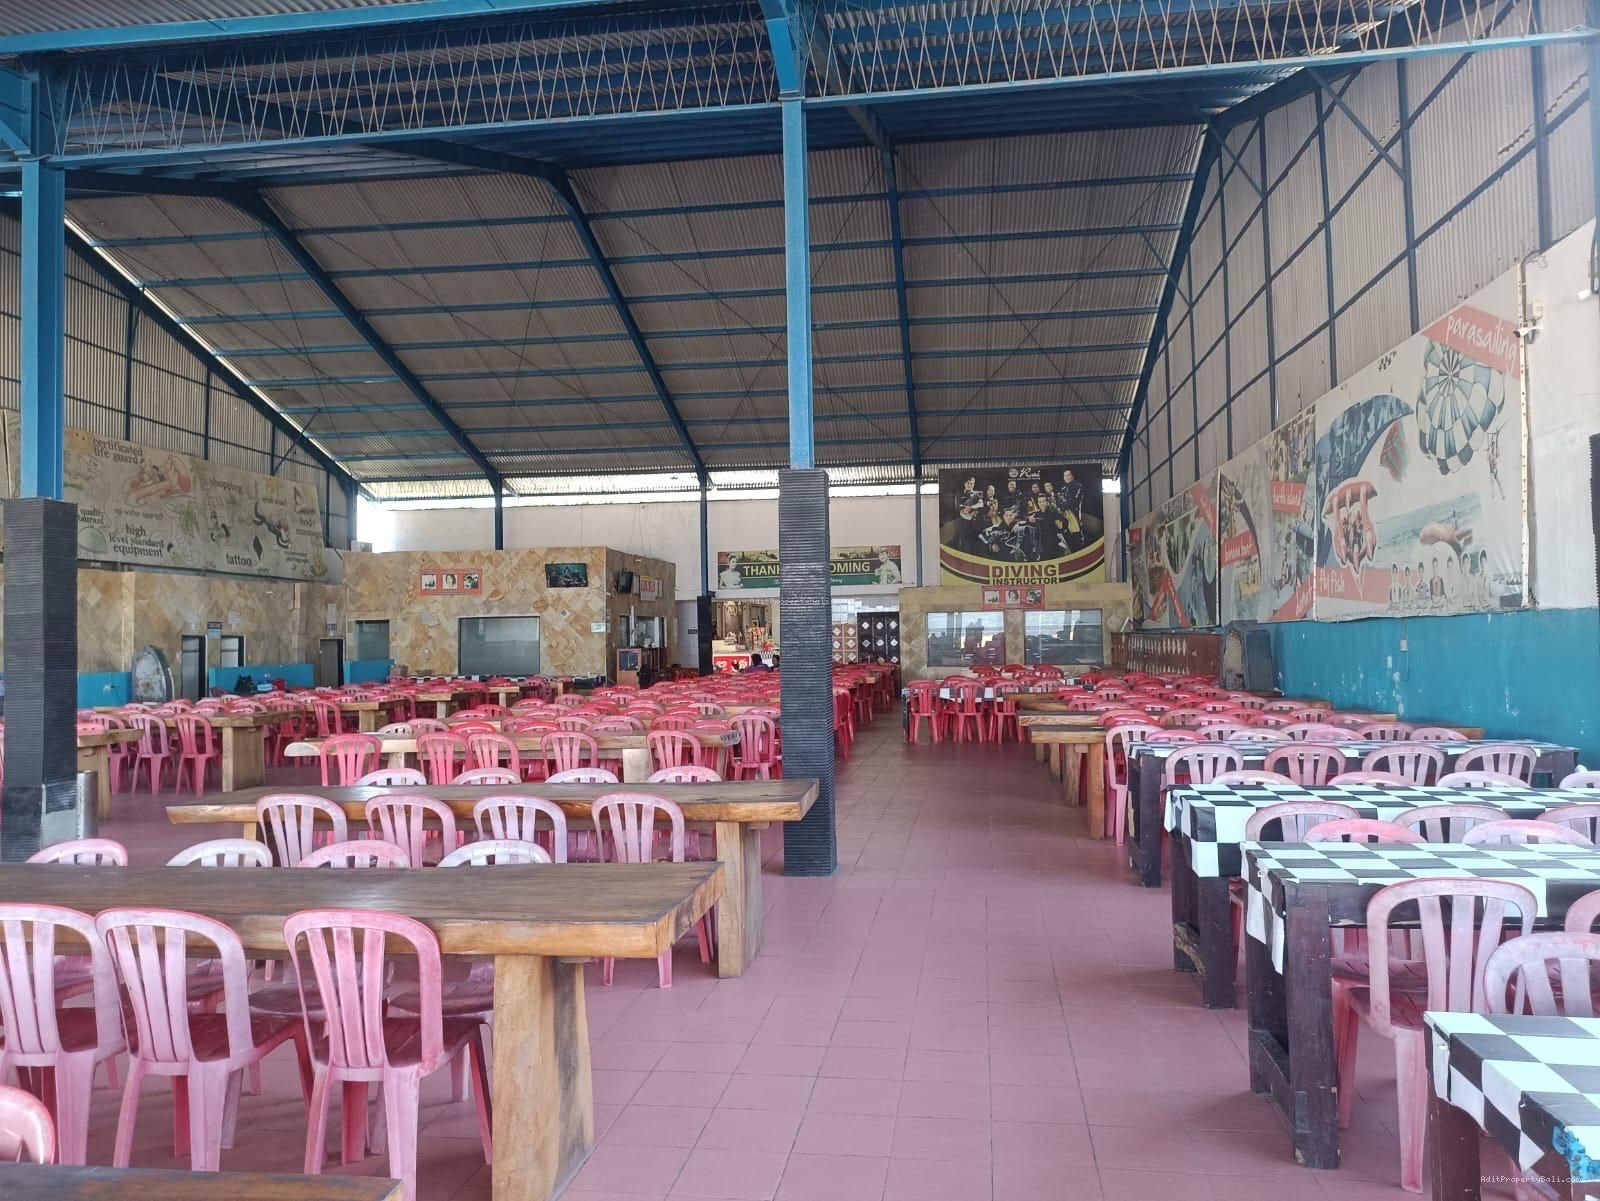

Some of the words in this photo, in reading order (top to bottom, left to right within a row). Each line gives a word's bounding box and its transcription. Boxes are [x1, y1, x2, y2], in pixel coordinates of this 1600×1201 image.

[1445, 315, 1517, 375] parasailing
[94, 447, 110, 458] life
[113, 453, 138, 465] guard
[126, 523, 146, 538] high
[109, 532, 128, 542] level
[130, 535, 164, 549] standard
[113, 543, 163, 558] equipment
[226, 552, 252, 566] tattoo
[991, 564, 1057, 578] DIVING
[992, 577, 1058, 586] INSTRUCTOR
